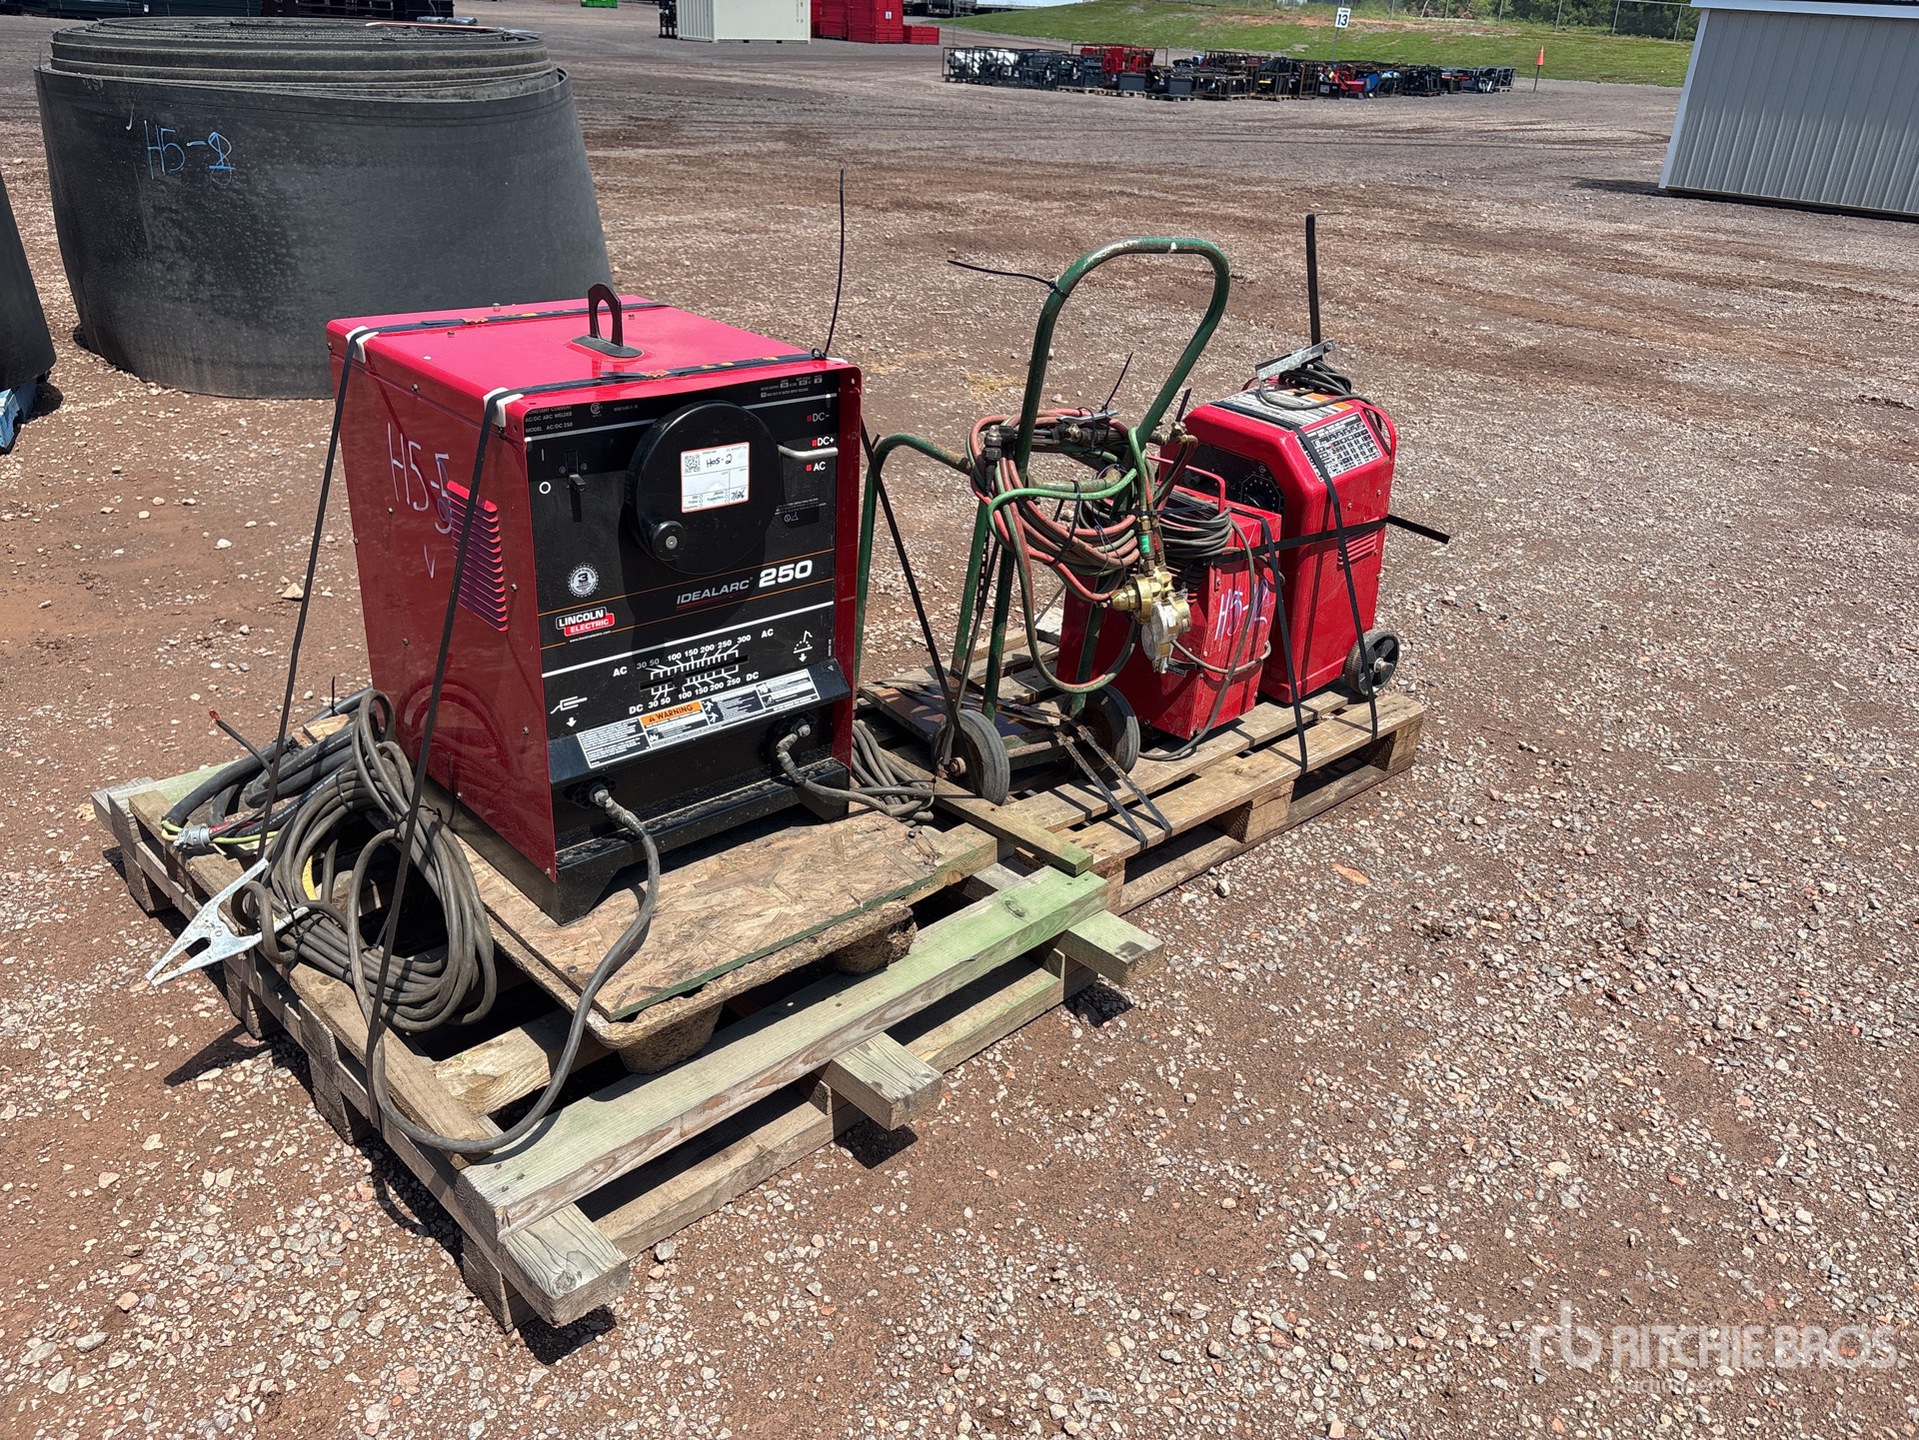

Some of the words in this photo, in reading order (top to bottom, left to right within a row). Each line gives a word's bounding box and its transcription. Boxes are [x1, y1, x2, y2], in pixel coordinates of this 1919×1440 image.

[1337, 13, 1348, 26] 13
[554, 411, 573, 419] WELDER
[525, 426, 543, 434] MODEL
[563, 421, 574, 429] 250
[813, 461, 826, 472] AC
[577, 572, 589, 583] 3
[675, 579, 751, 605] IDEALARC
[758, 560, 813, 588] 250
[558, 609, 604, 628] LINCOLN
[570, 618, 610, 634] ELECTRIC
[612, 665, 628, 678] AC
[636, 661, 648, 671] 30
[648, 658, 661, 667] 50
[666, 652, 683, 662] 100
[684, 647, 699, 658] 150
[699, 643, 716, 654] 200
[717, 639, 733, 650] 250
[736, 634, 752, 645] 300
[760, 628, 774, 640] AC
[629, 702, 645, 716] DC
[647, 699, 660, 709] 30
[659, 696, 672, 706] 50
[678, 690, 693, 701] 100
[694, 686, 710, 697] 150
[709, 682, 725, 693] 200
[726, 676, 742, 688] 250
[745, 671, 760, 682] DC
[655, 703, 694, 720] WARNING
